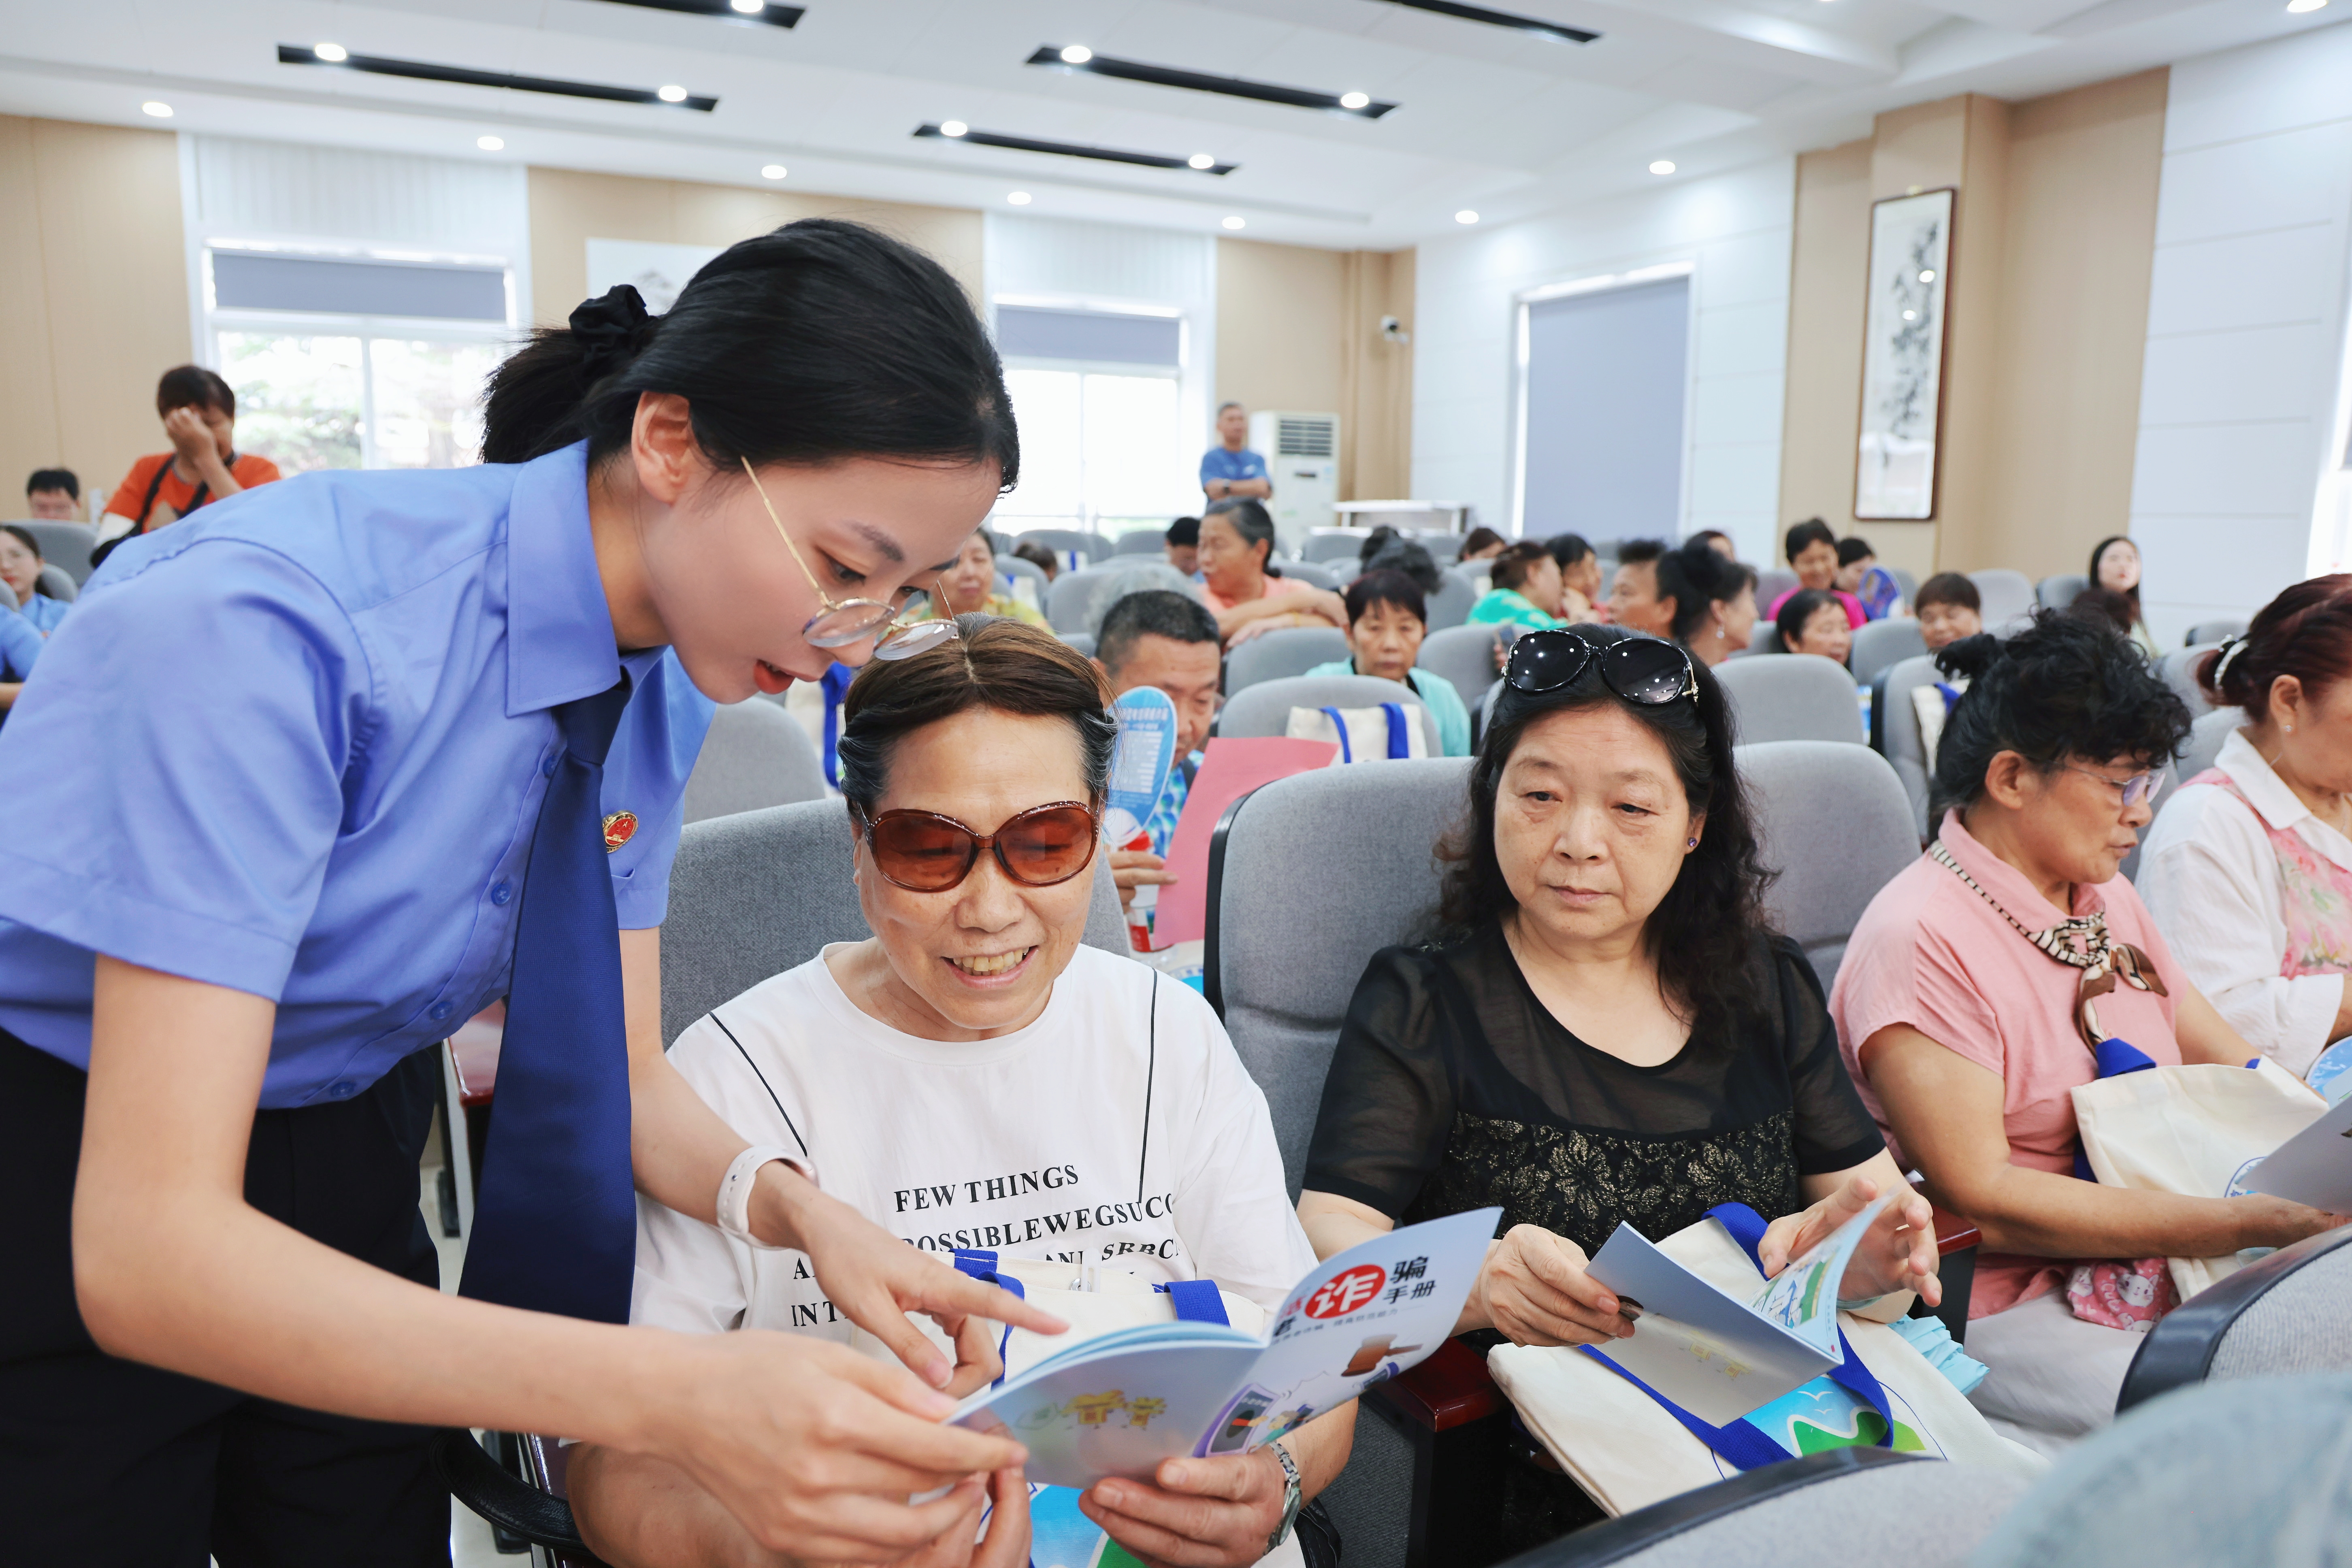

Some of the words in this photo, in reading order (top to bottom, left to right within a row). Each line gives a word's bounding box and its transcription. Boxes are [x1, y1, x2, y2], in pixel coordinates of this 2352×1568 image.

[894, 1183, 957, 1212] FEW
[964, 1165, 1079, 1204] THINGS
[901, 1193, 1172, 1251] OSSIBLEWEGSUC
[794, 1257, 816, 1279] A
[1102, 1238, 1179, 1259] SRBC
[1312, 1272, 1379, 1318] 诈
[1389, 1256, 1429, 1284] 骗
[1383, 1280, 1436, 1304] 手册
[791, 1301, 848, 1326] INT
